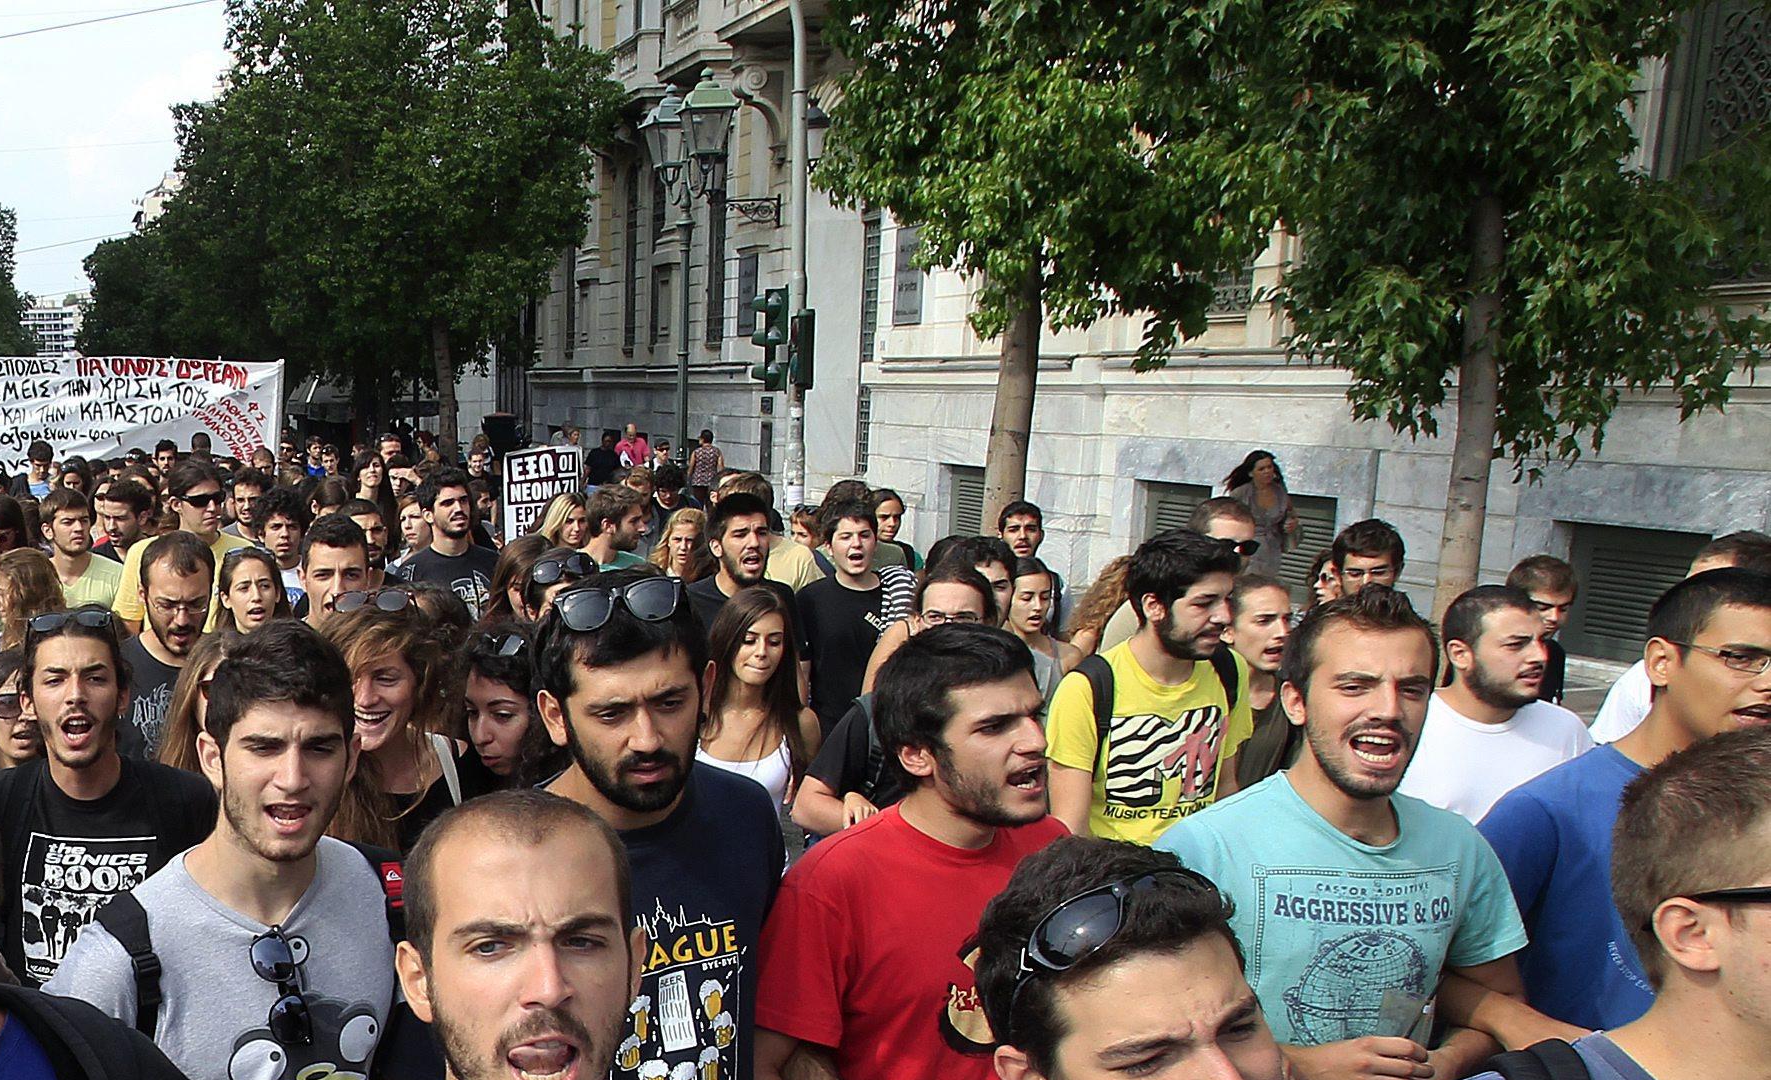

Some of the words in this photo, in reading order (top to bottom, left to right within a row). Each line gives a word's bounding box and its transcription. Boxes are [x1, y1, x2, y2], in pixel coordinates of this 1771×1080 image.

[511, 453, 556, 482] ΕΞΩ
[1103, 805, 1148, 819] MUSIC
[48, 843, 87, 855] the
[44, 853, 148, 866] SONICS
[1274, 893, 1409, 926] AGGRESSIVE
[1414, 901, 1427, 924] &
[1430, 895, 1453, 921] CO.
[702, 956, 737, 971] BYE-BYE
[659, 974, 685, 989] BEER
